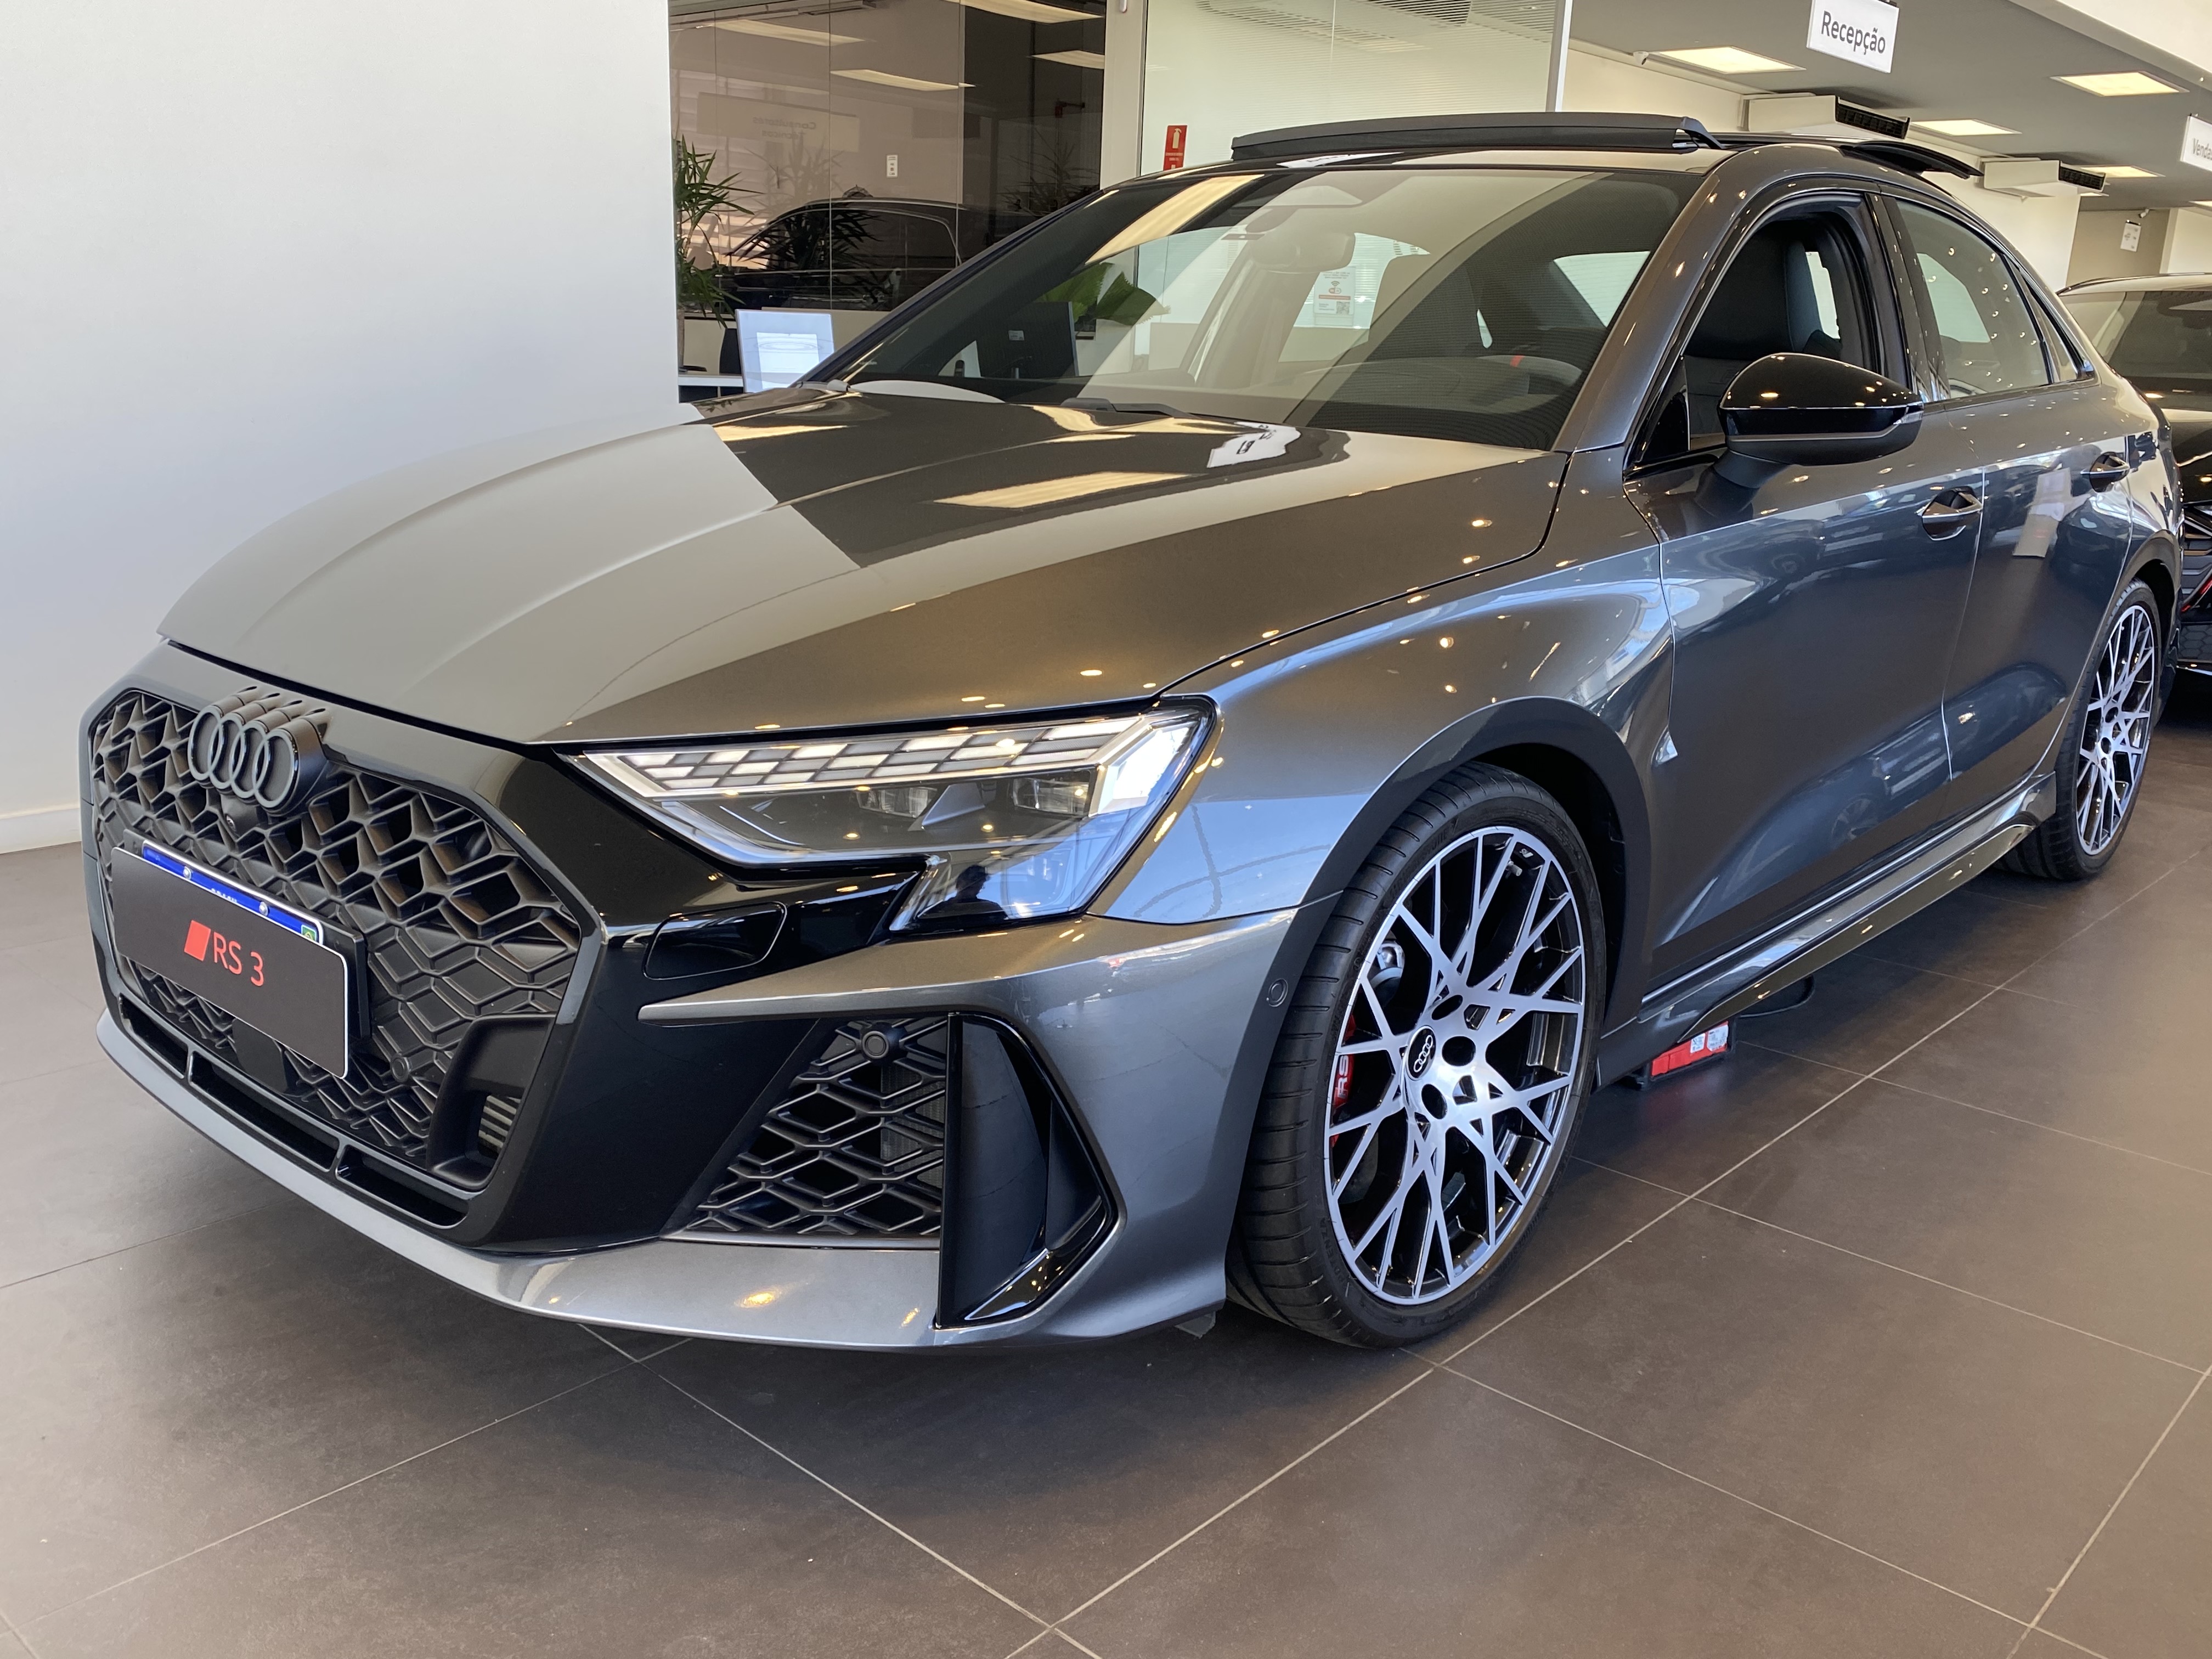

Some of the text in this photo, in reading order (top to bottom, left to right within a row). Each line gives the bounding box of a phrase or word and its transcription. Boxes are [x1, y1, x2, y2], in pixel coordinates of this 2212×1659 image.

[1821, 10, 1886, 55] Recepção
[213, 932, 264, 986] RS 3
[1338, 1054, 1349, 1098] RS
